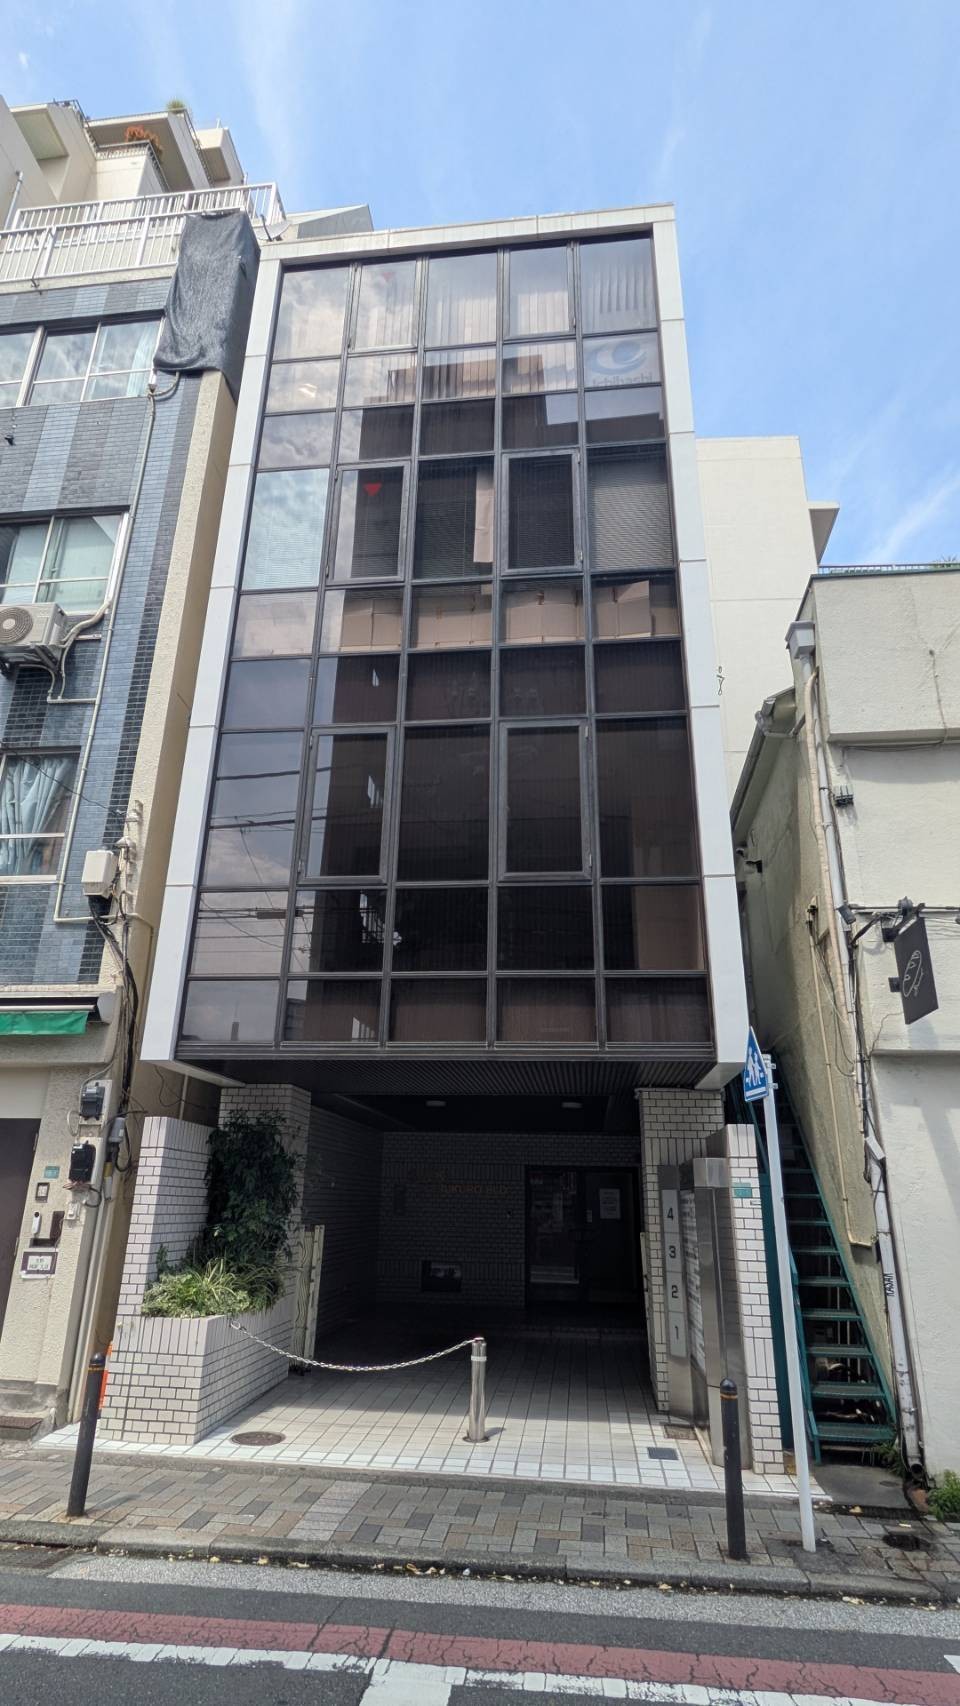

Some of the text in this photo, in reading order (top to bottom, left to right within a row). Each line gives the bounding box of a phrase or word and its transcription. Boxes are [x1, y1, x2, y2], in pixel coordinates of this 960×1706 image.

[667, 1207, 674, 1220] 4
[668, 1245, 676, 1258] 3
[671, 1284, 679, 1298] 2
[674, 1324, 679, 1340] 1
